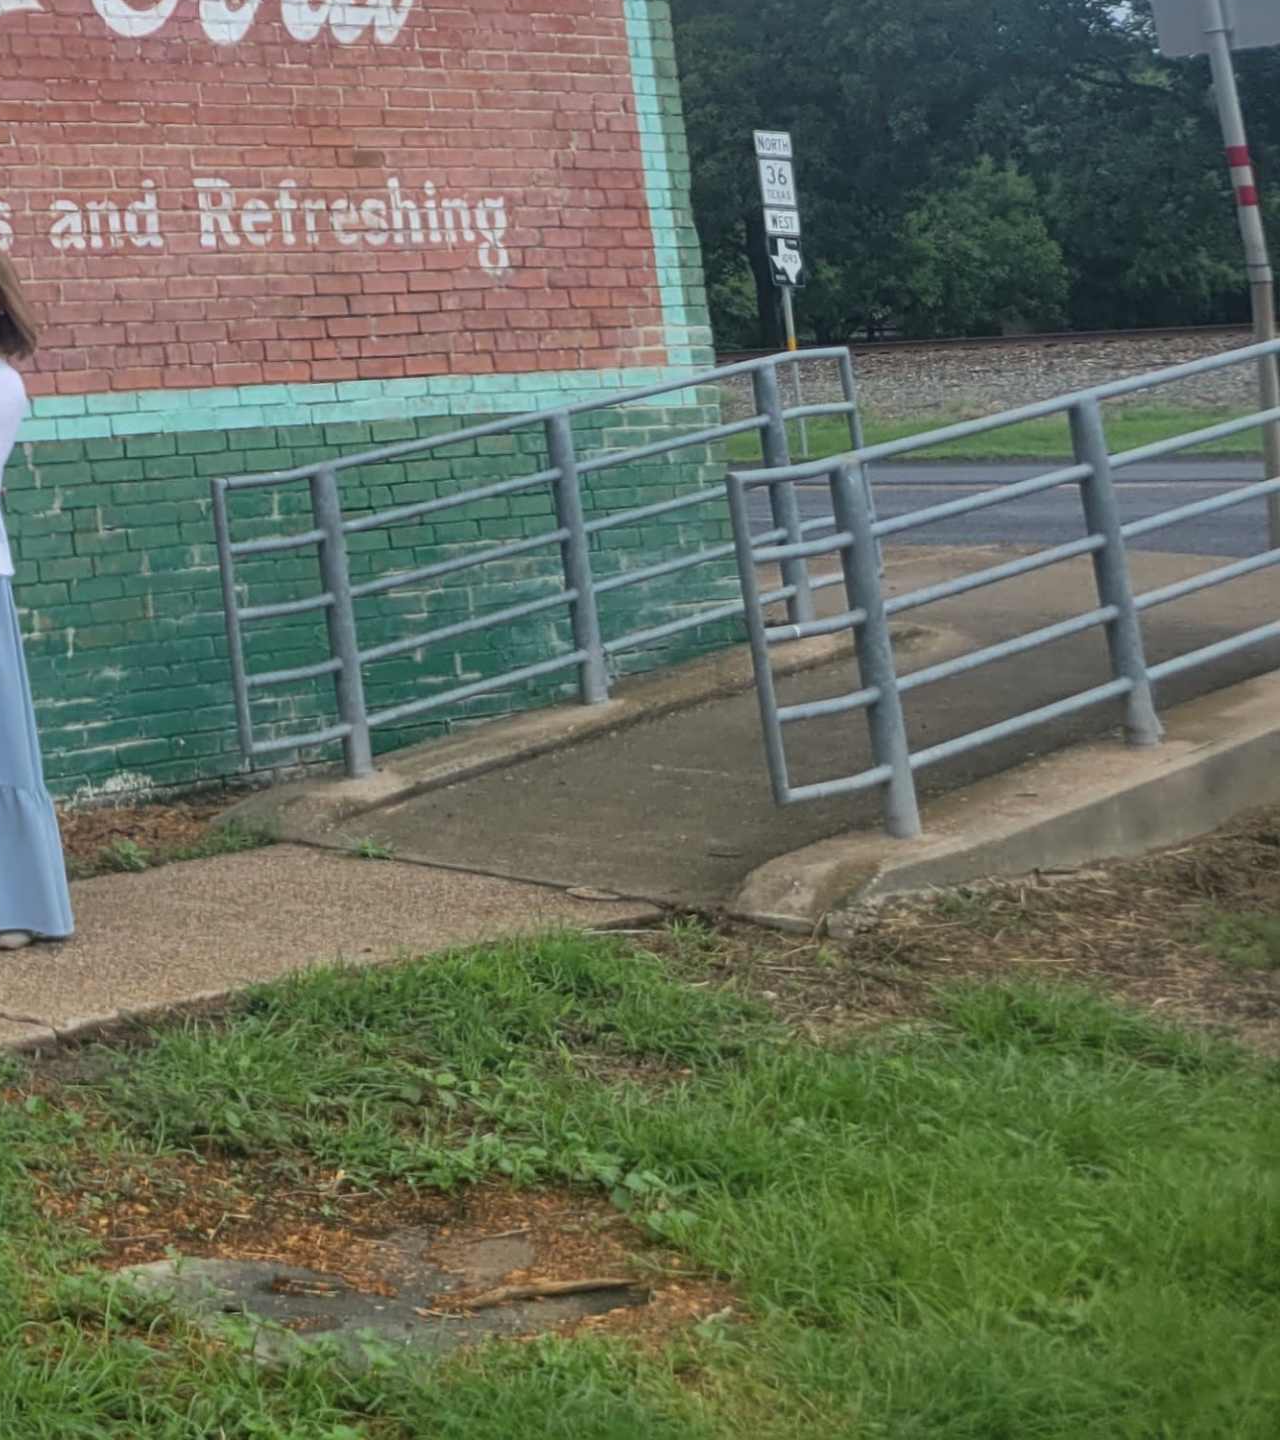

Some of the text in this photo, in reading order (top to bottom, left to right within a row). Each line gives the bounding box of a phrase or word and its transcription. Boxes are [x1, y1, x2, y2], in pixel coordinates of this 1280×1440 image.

[757, 137, 789, 152] NORTH
[767, 166, 787, 185] 36
[767, 190, 790, 201] TEXAS
[48, 180, 164, 250] and
[192, 177, 510, 277] Refreshing
[771, 214, 794, 229] WEST
